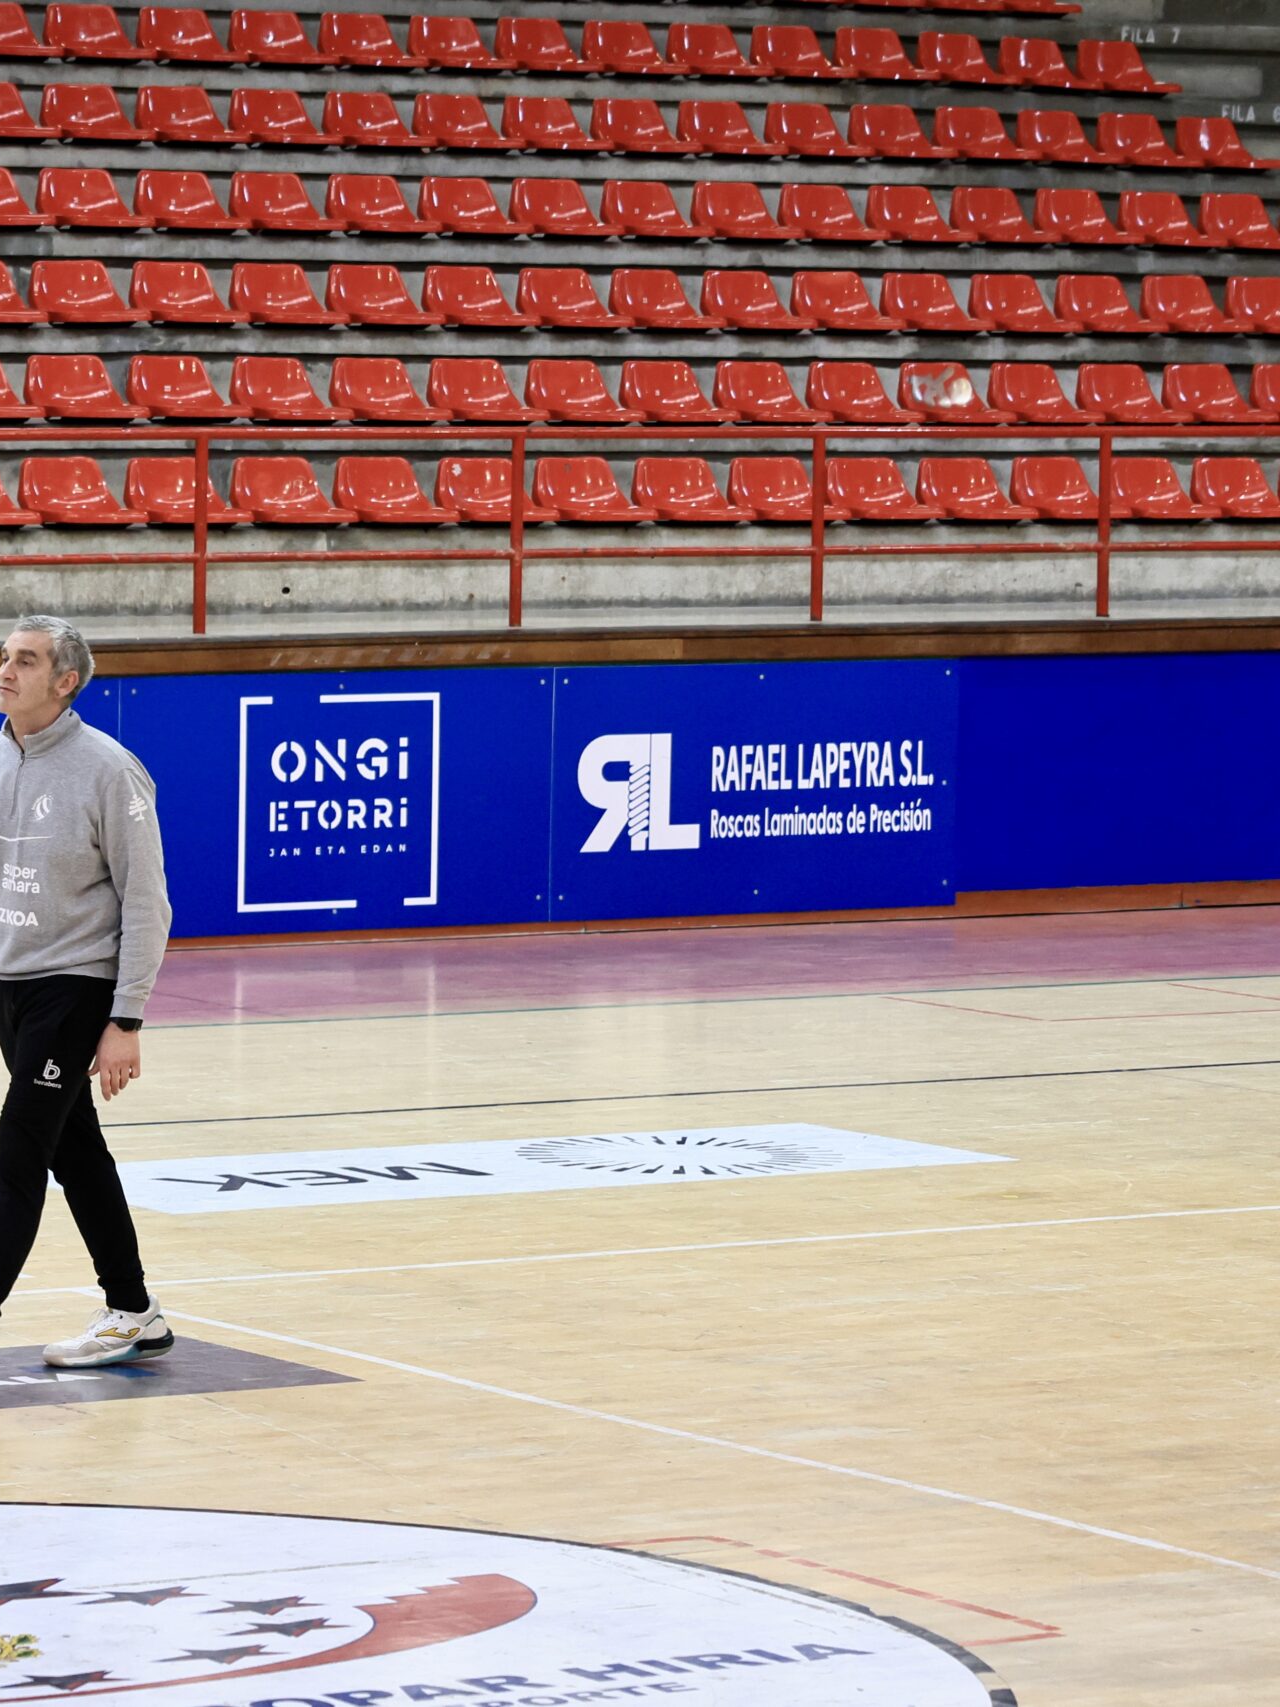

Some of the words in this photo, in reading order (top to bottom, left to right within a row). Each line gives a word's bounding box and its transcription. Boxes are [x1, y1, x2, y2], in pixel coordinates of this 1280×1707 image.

[1121, 27, 1156, 44] FILA
[1172, 28, 1182, 44] 7
[711, 743, 792, 792] RAFAEL
[797, 740, 895, 790] LAPEYRA
[899, 740, 934, 787] S.L.
[710, 808, 760, 839] Roscas
[764, 803, 843, 837] Laminadas
[847, 804, 865, 834] de
[870, 798, 932, 833] Precisión
[269, 847, 301, 857] JAN
[315, 845, 346, 855] ETA
[360, 844, 407, 854] EDAN
[559, 1643, 876, 1682] HIRIA
